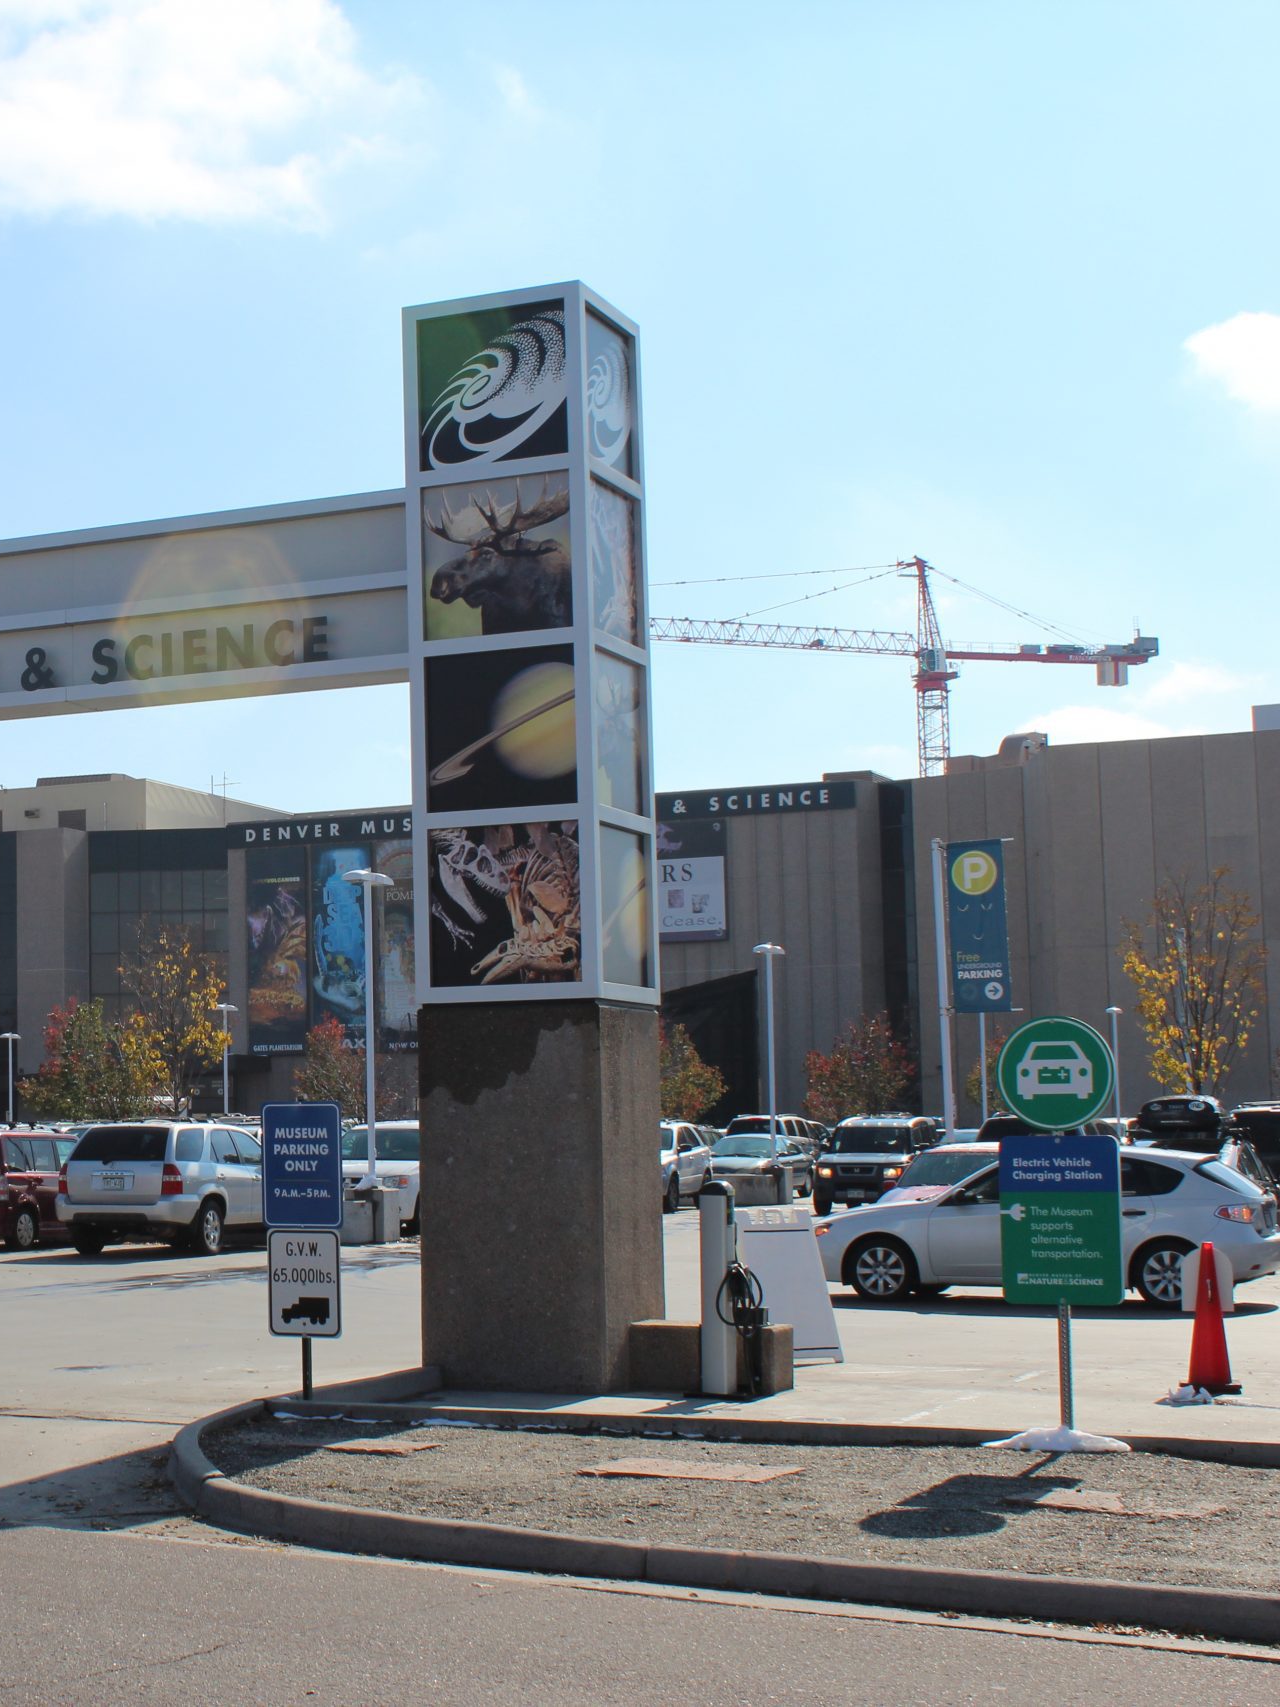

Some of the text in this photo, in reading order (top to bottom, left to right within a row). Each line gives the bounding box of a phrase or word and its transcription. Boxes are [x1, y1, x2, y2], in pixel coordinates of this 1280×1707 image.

[20, 646, 55, 692] &
[91, 615, 330, 685] SCIENCE
[672, 789, 830, 814] & SCIENCE
[245, 822, 341, 843] DENVER
[963, 856, 989, 889] P
[957, 969, 1004, 979] PARKING
[274, 1127, 328, 1139] MUSEUM
[273, 1143, 329, 1155] PARKING
[284, 1160, 318, 1172] ONLY
[1012, 1157, 1092, 1168] Electric Vehicle
[1012, 1170, 1103, 1182] Charging Station
[1030, 1206, 1093, 1217] The Museum
[1030, 1221, 1074, 1232] supports
[1031, 1234, 1083, 1245] alternative
[285, 1241, 322, 1257] G.V.W.
[1031, 1248, 1103, 1260] transportation.
